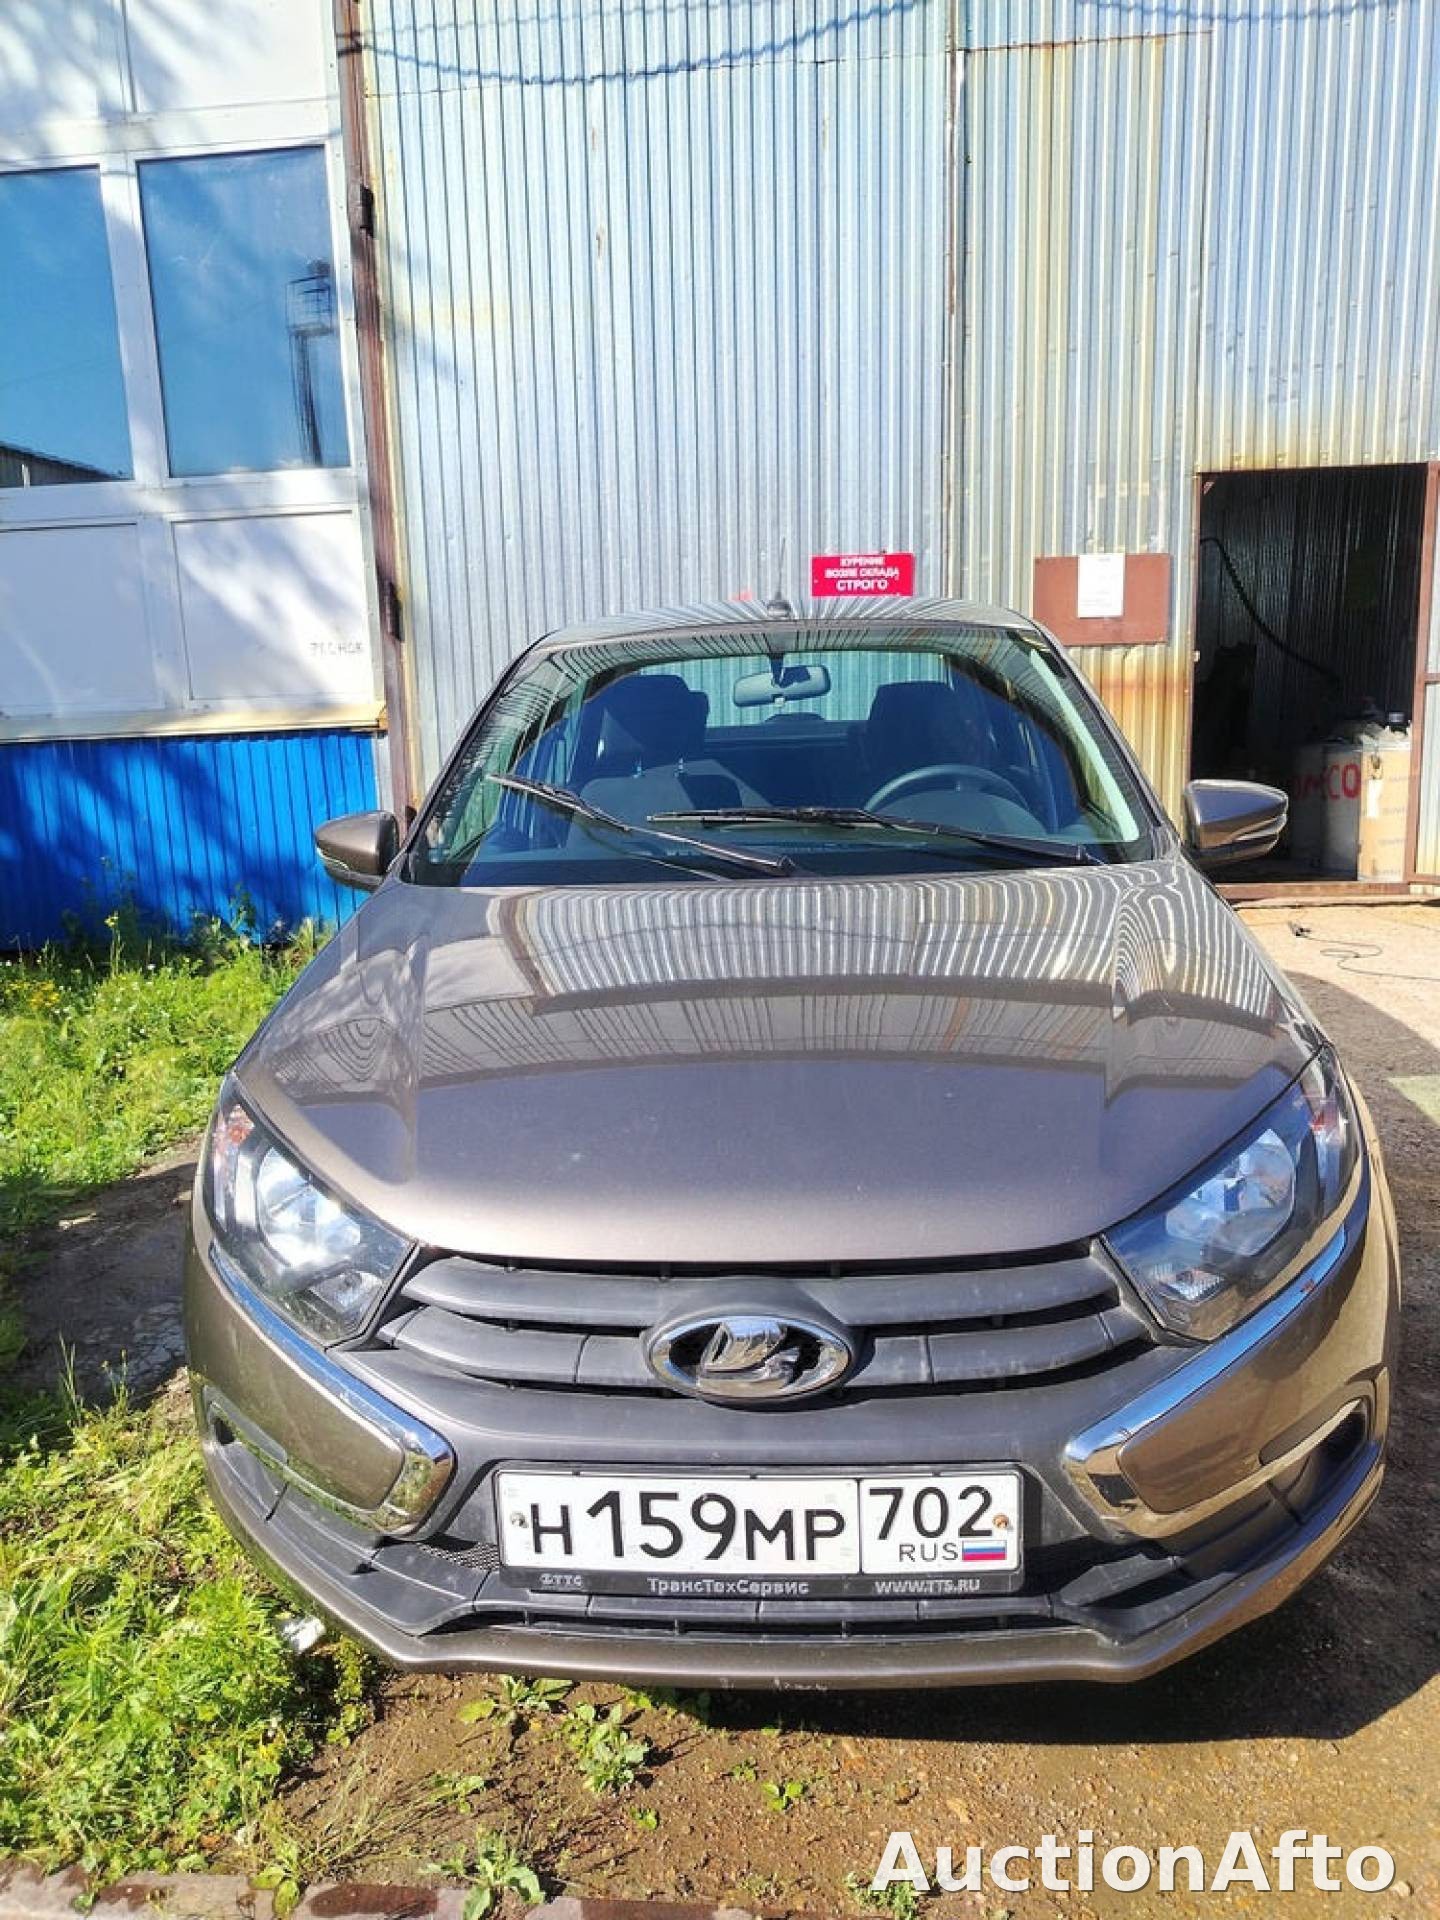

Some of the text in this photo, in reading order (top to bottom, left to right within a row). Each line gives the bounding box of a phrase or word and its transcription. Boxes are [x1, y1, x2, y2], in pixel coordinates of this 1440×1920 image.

[836, 579, 888, 591] СТРОГО
[530, 1484, 993, 1561] Н159МР 702
[898, 1542, 959, 1562] RUS
[647, 1577, 809, 1597] ТрансТехСервис
